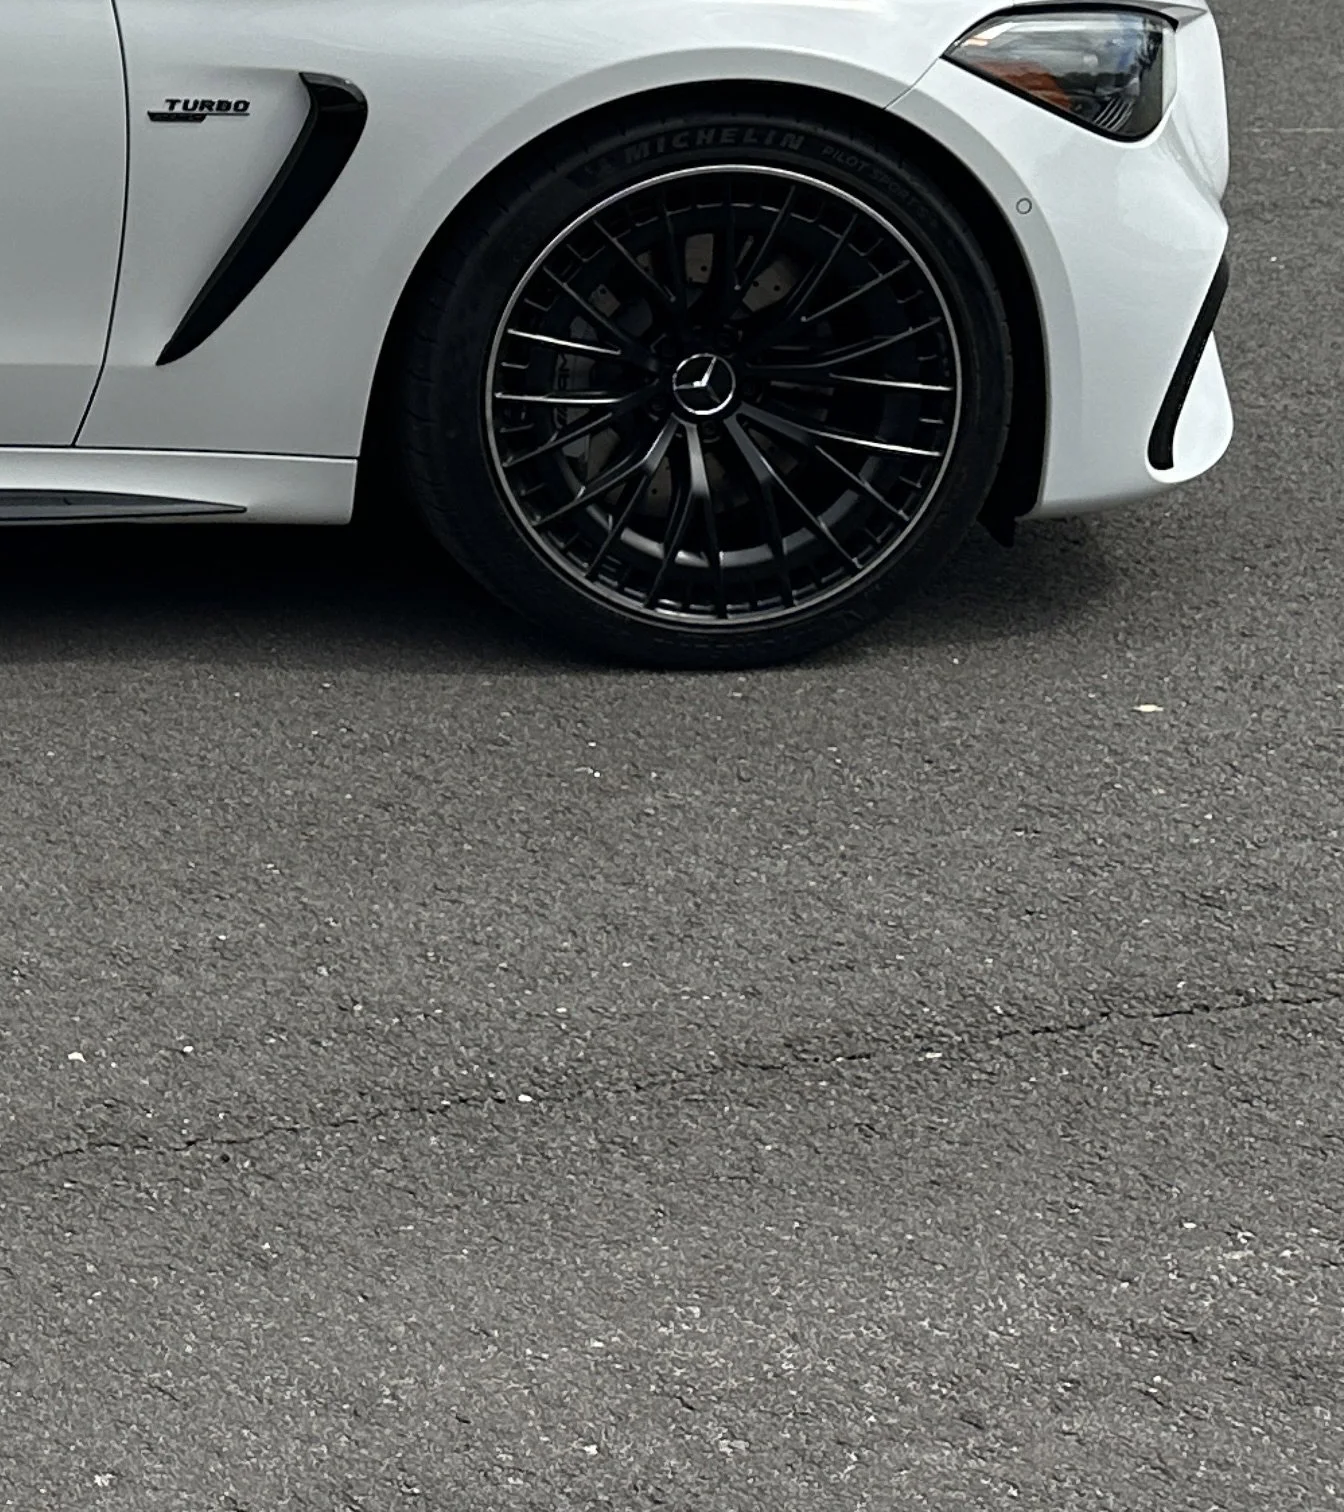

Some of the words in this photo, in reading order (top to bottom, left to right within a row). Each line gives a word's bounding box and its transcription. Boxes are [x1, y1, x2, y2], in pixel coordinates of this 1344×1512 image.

[164, 98, 251, 112] TURBO
[621, 127, 804, 163] MICHELIN
[820, 144, 870, 173] PILOT
